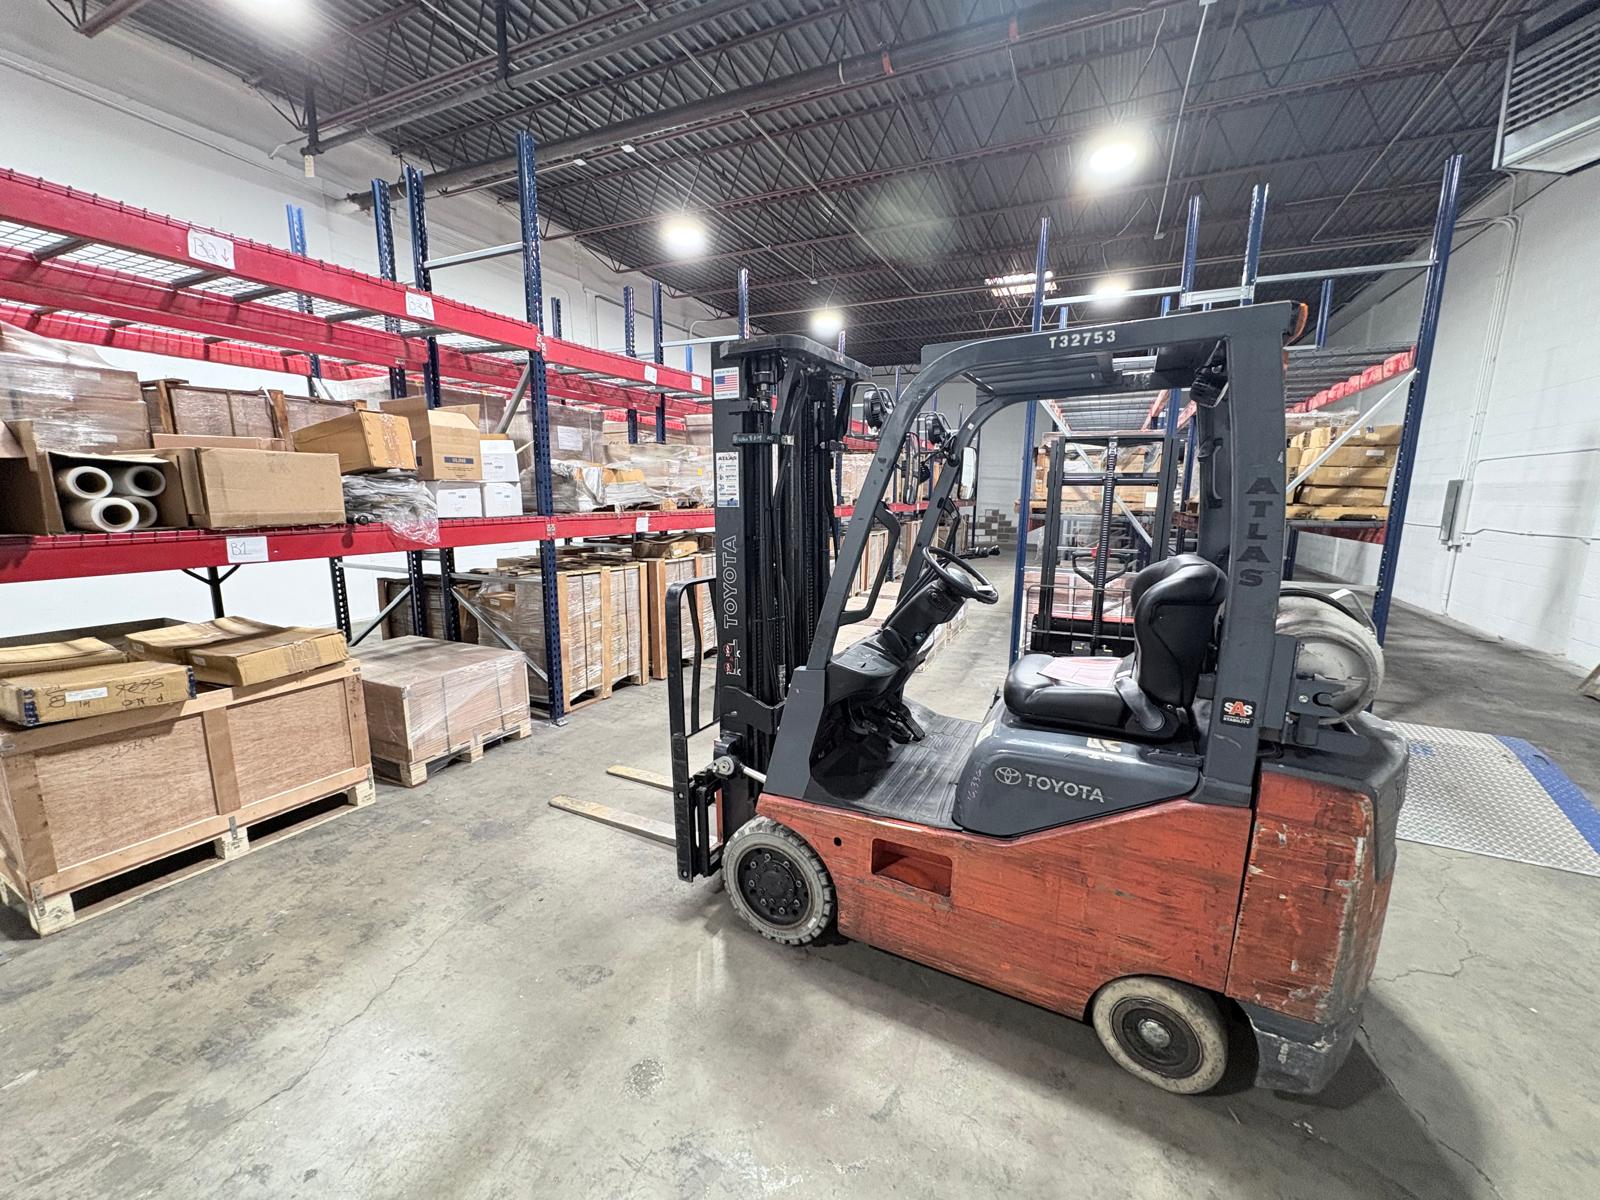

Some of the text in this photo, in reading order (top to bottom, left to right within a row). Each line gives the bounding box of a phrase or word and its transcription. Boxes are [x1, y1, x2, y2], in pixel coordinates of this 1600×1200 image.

[1049, 330, 1116, 349] T32753
[1236, 477, 1280, 587] ATLAS
[231, 541, 254, 556] B1
[722, 535, 738, 629] TOYOTA
[1223, 701, 1253, 717] SAS
[1025, 773, 1105, 803] TOYOTA
